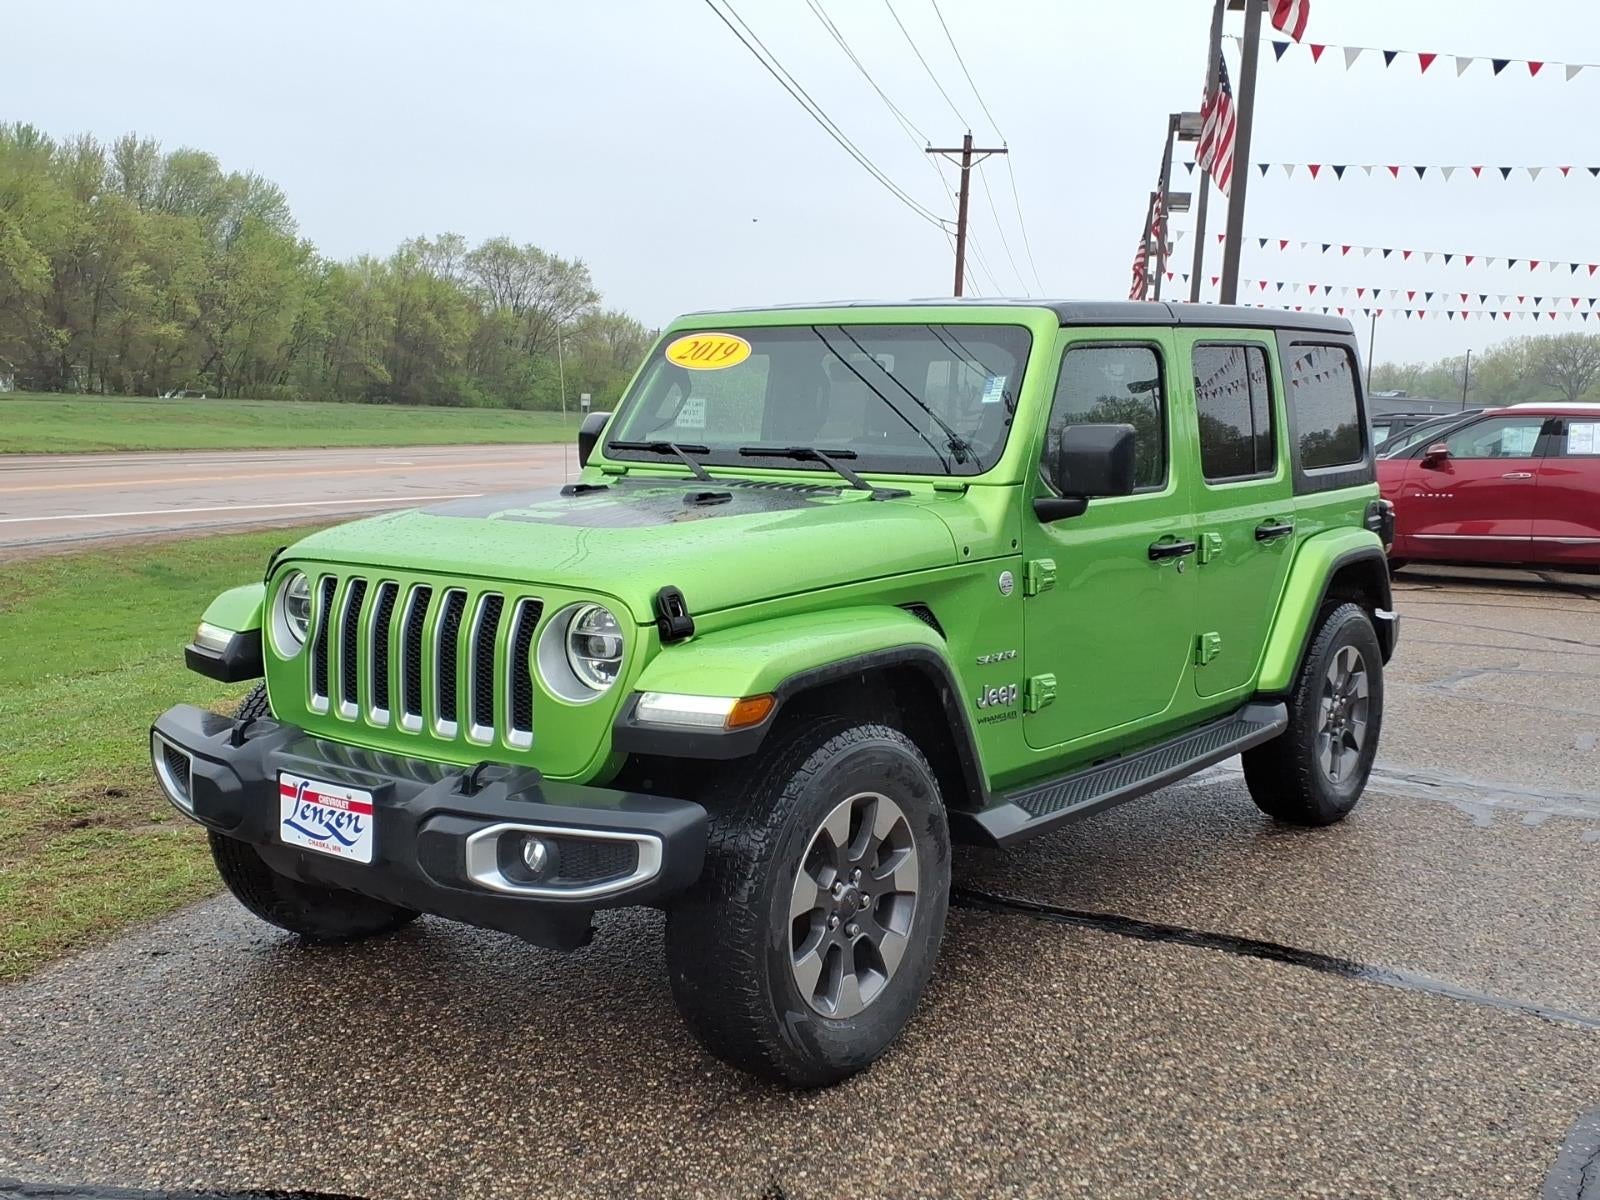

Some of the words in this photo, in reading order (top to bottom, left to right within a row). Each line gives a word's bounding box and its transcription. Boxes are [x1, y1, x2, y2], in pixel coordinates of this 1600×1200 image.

[676, 341, 740, 361] 2019
[976, 683, 1017, 709] Jeep
[977, 710, 1017, 724] WRANGLER
[318, 795, 349, 809] CHEVROLET
[283, 781, 365, 846] Lenzen
